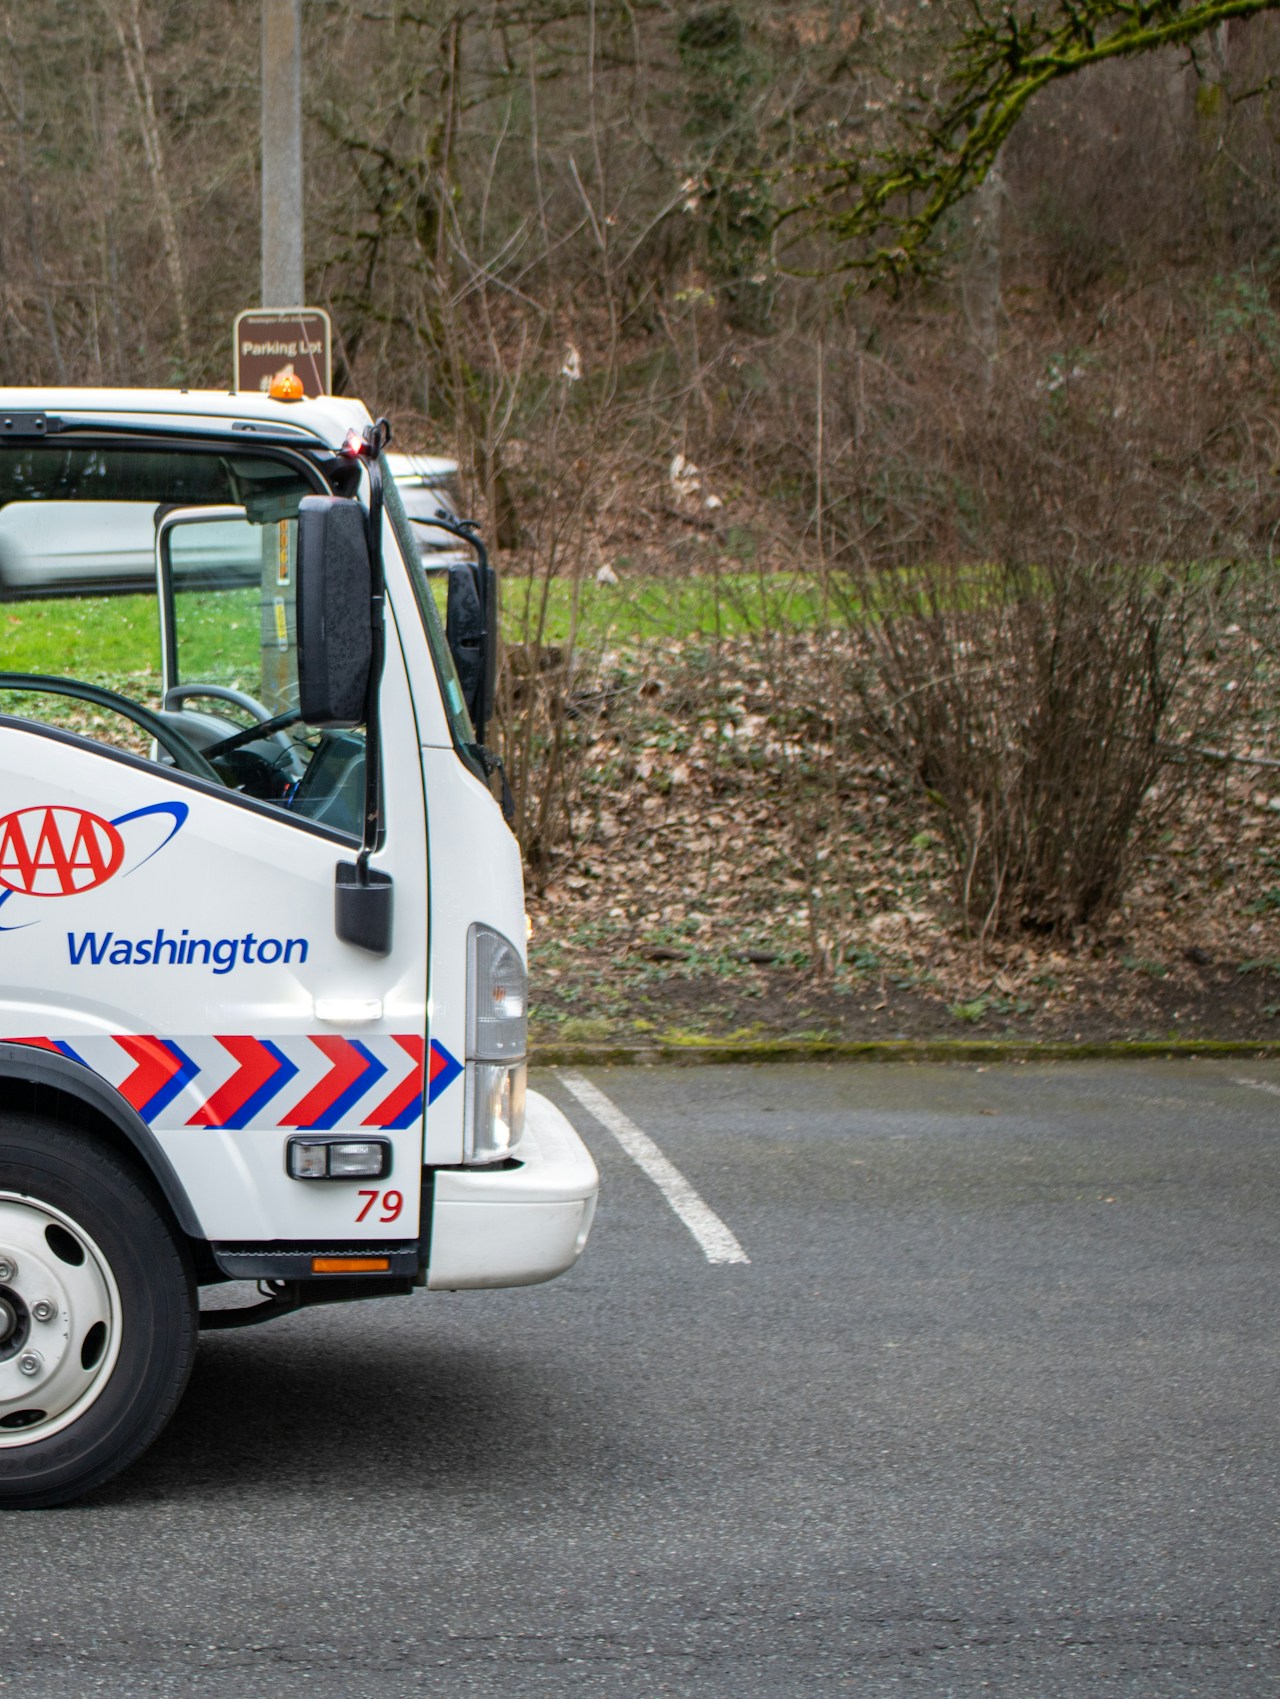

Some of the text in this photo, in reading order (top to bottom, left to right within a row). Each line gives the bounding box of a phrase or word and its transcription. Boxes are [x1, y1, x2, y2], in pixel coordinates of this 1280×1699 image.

[242, 341, 322, 357] Parking Lot
[67, 929, 309, 974] Washington
[355, 1189, 404, 1223] 79
